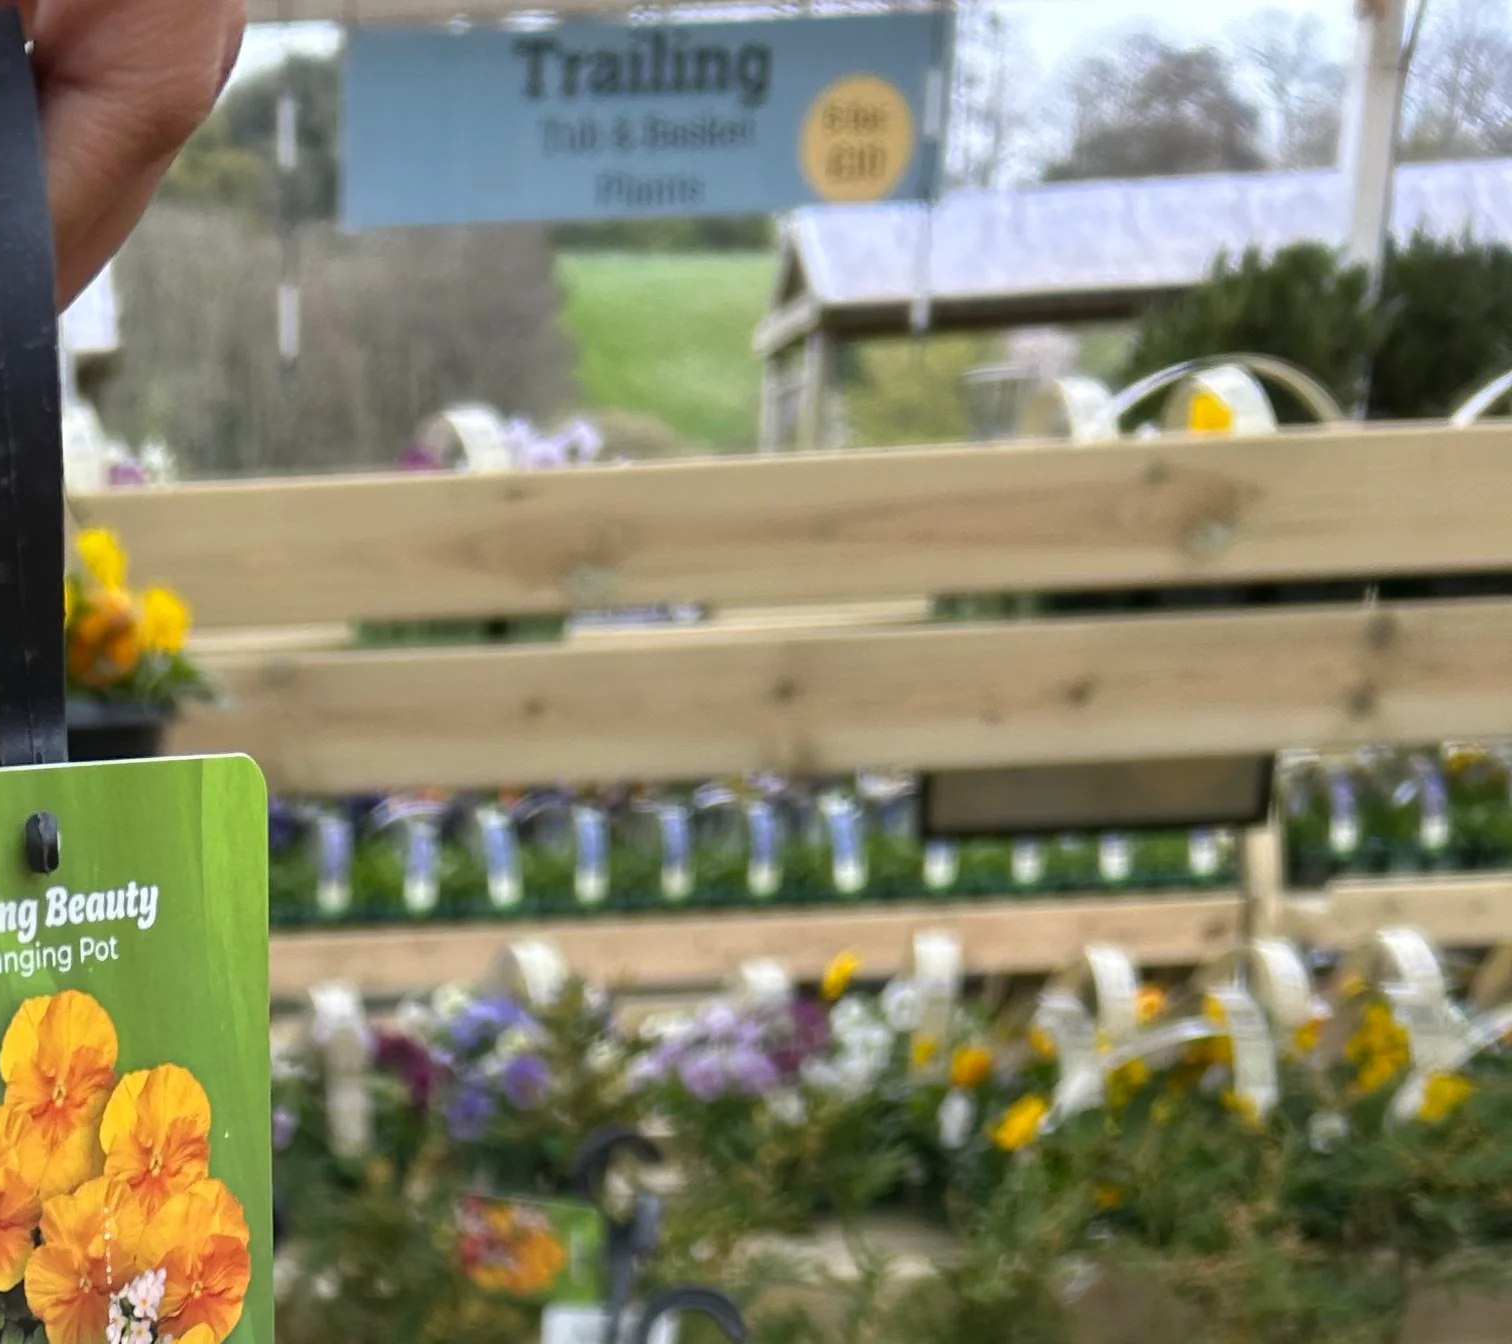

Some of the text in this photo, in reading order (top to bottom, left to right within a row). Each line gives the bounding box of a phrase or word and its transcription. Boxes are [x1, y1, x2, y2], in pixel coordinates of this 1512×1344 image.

[515, 32, 773, 105] Trailing
[45, 880, 159, 930] Beauty
[80, 936, 119, 964] Pot
